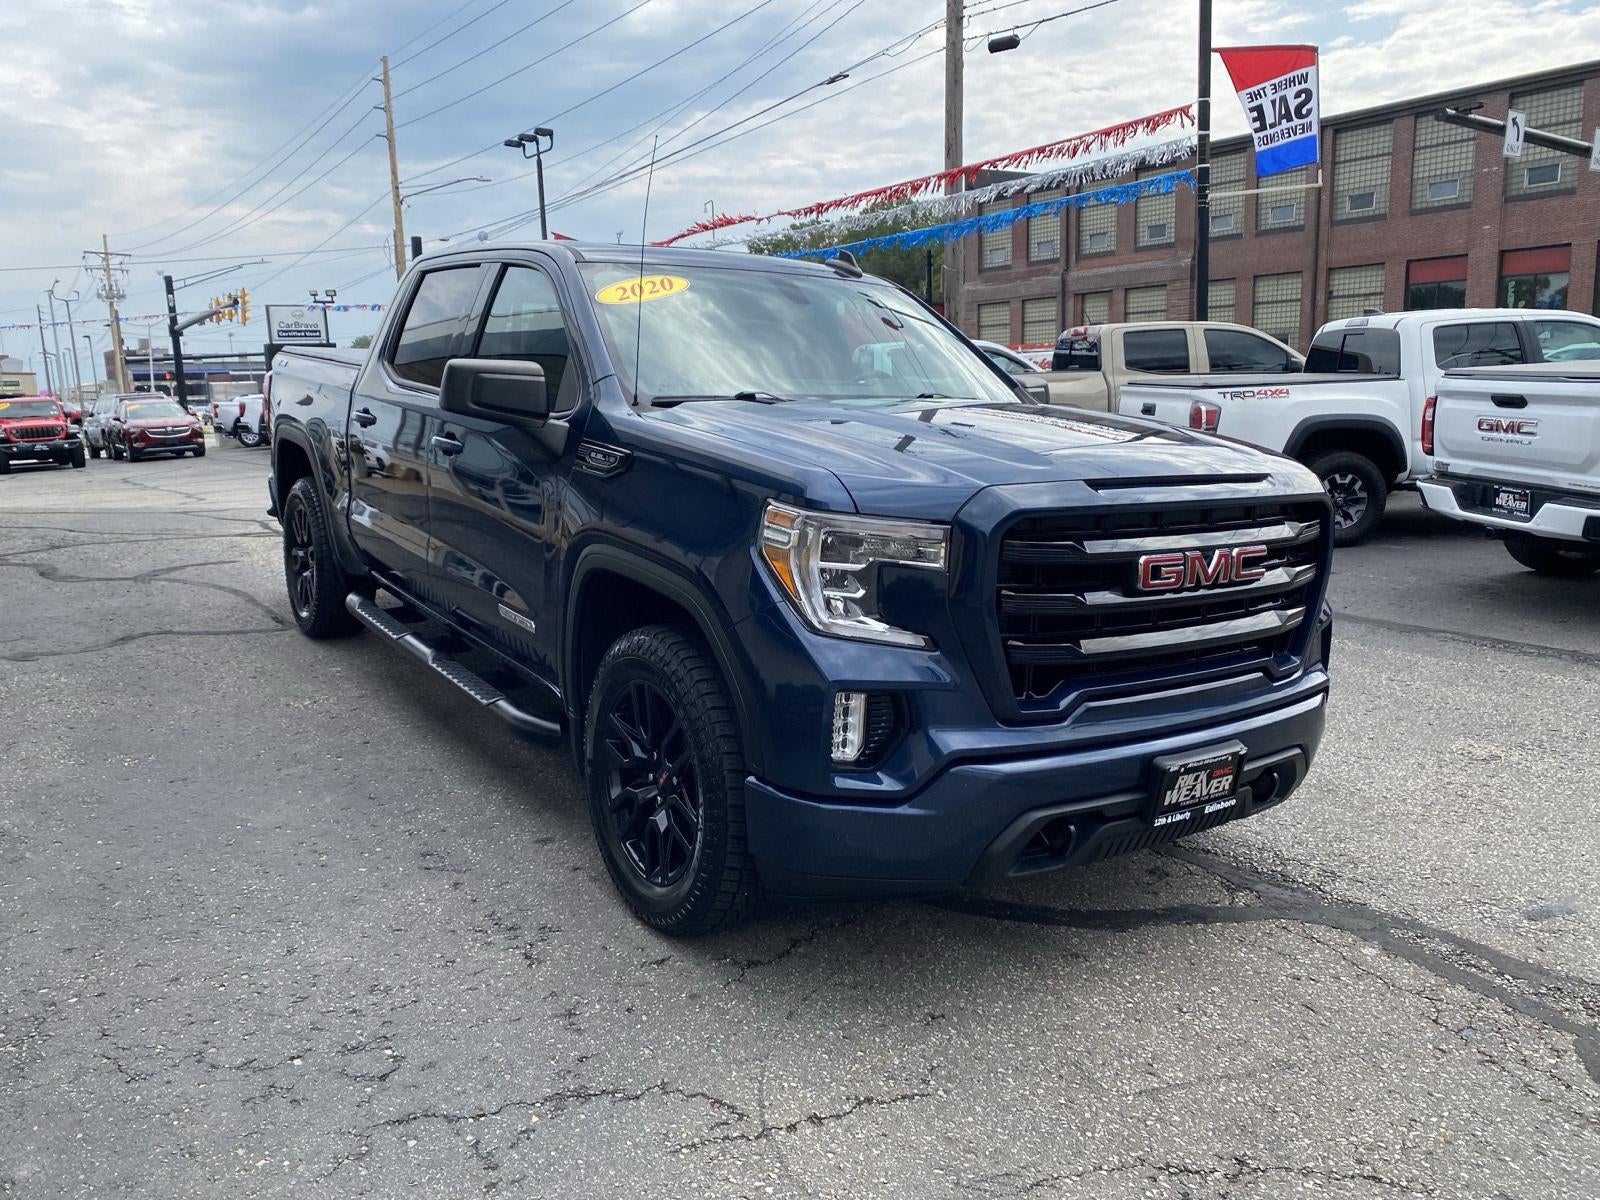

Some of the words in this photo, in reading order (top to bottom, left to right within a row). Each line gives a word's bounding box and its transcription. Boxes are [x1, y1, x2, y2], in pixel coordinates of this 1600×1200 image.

[615, 277, 674, 301] 2020
[278, 320, 319, 329] CarBravo
[1477, 417, 1538, 436] GMC
[1495, 496, 1527, 510] WEAVER
[1138, 545, 1268, 591] GMC
[1175, 769, 1210, 789] RICK
[1212, 766, 1233, 777] GMC
[1163, 775, 1233, 806] WEAVER
[1204, 798, 1237, 814] Edinboro
[1172, 811, 1191, 822] Liberty
